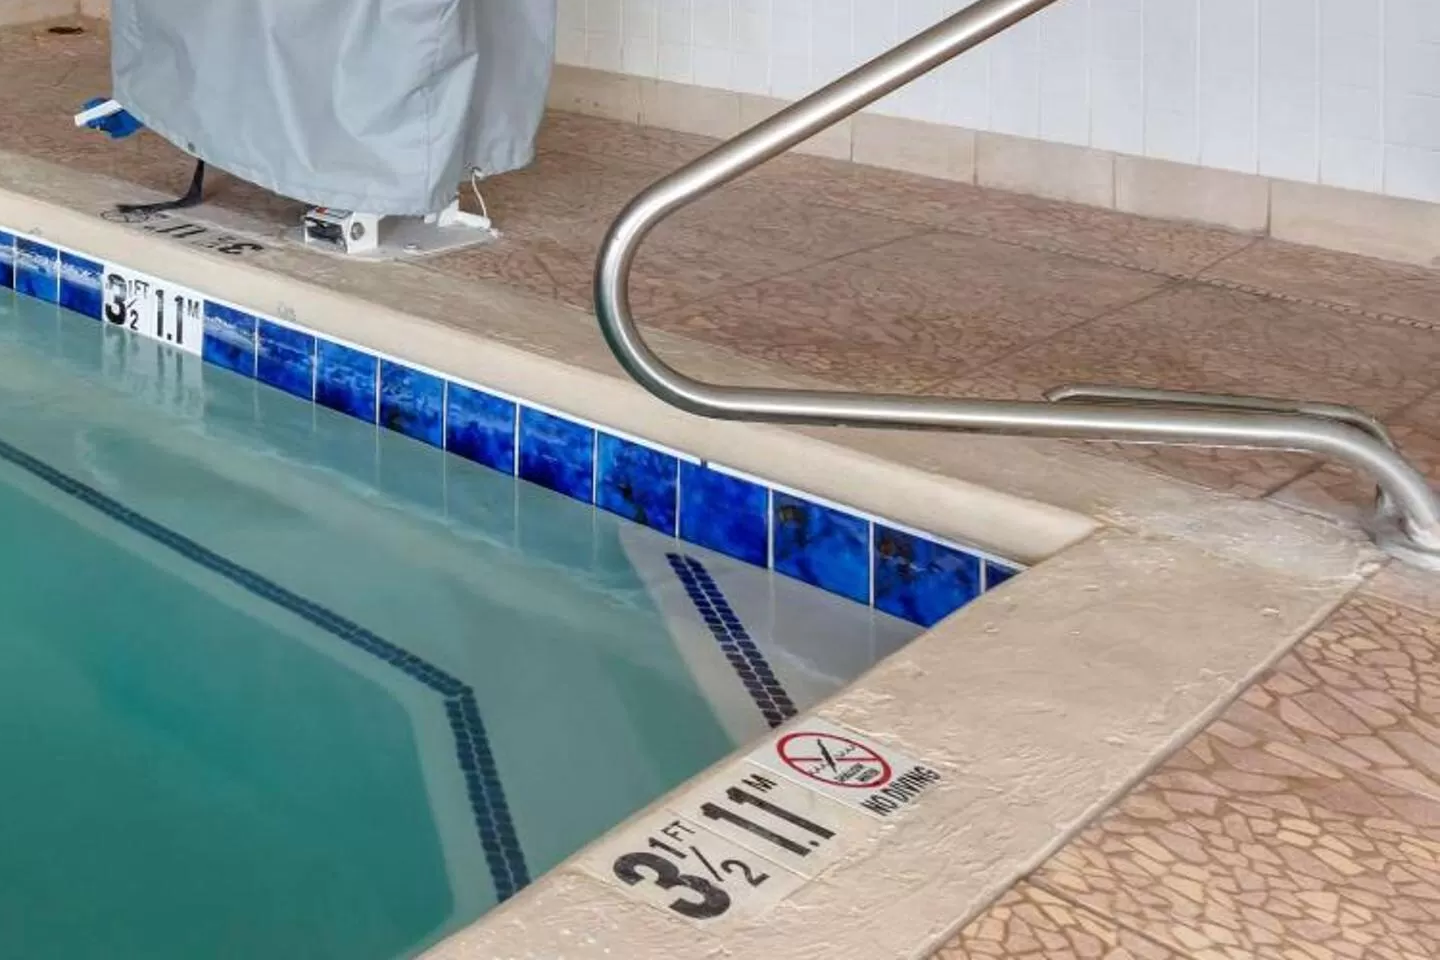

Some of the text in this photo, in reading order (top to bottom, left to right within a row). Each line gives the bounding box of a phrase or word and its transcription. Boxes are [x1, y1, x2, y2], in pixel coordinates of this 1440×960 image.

[105, 273, 127, 326] 3
[155, 289, 185, 344] 1.1
[741, 773, 778, 793] M
[860, 793, 899, 817] NO
[888, 765, 942, 804] DIVING
[661, 819, 696, 843] FT
[699, 785, 837, 857] 1.1
[613, 851, 732, 919] 3
